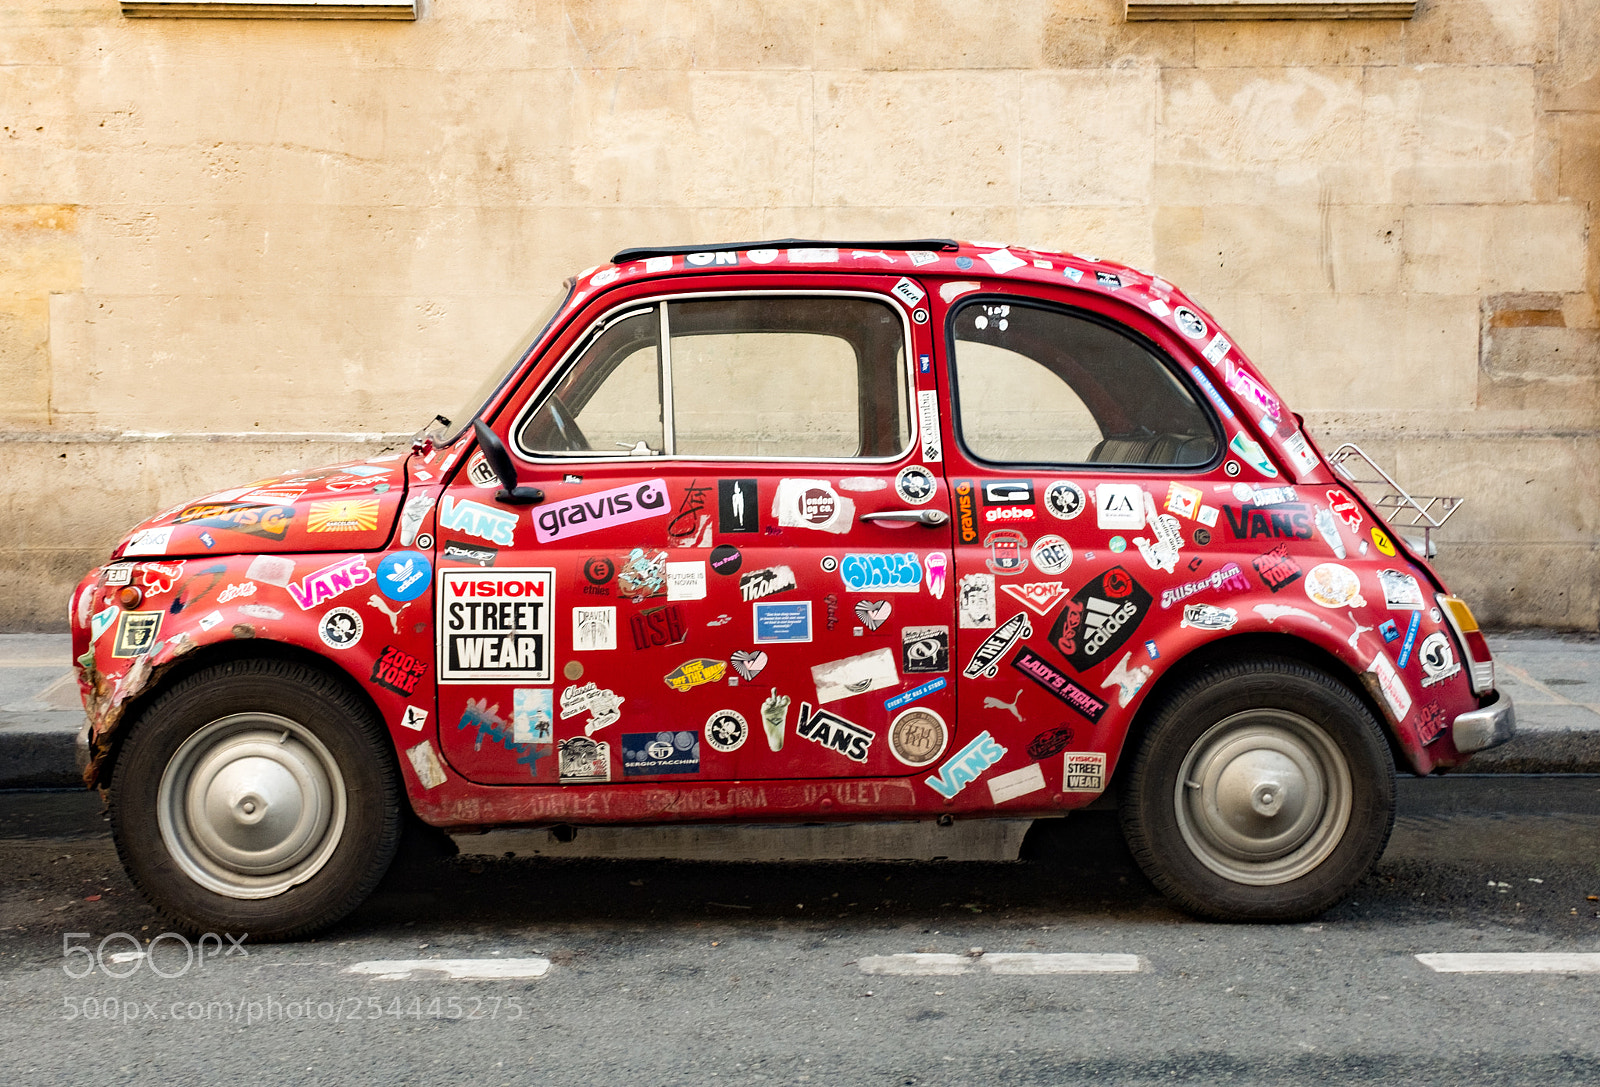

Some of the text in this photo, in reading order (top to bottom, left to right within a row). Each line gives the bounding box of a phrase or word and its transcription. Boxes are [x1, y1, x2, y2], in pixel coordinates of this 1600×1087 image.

[920, 393, 932, 445] Columbia
[180, 505, 258, 524] gravis
[539, 493, 633, 537] gravis
[986, 507, 1034, 521] globe
[1105, 494, 1134, 511] LA
[441, 496, 519, 545] VANS
[960, 496, 977, 542] gravis
[1222, 504, 1313, 540] VANS
[288, 555, 371, 608] VANS
[397, 570, 423, 592] adidas
[1262, 562, 1301, 587] YORK
[450, 581, 544, 597] VISION
[583, 586, 610, 596] etnies
[1026, 584, 1059, 597] PONY
[449, 602, 543, 630] STREET
[1084, 601, 1137, 655] adidas
[382, 646, 415, 671] ZOO
[456, 638, 536, 668] WEAR
[980, 637, 1002, 663] THE
[376, 661, 419, 694] YORK
[681, 661, 704, 674] VANS
[686, 671, 704, 683] THE
[565, 683, 596, 700] Classic
[1019, 654, 1103, 713] LADY'S FIGHT
[798, 704, 873, 761] VANS
[625, 760, 656, 768] SERGIO
[926, 731, 1005, 798] VANS
[1068, 763, 1101, 775] STREET
[1069, 776, 1099, 788] WEAR
